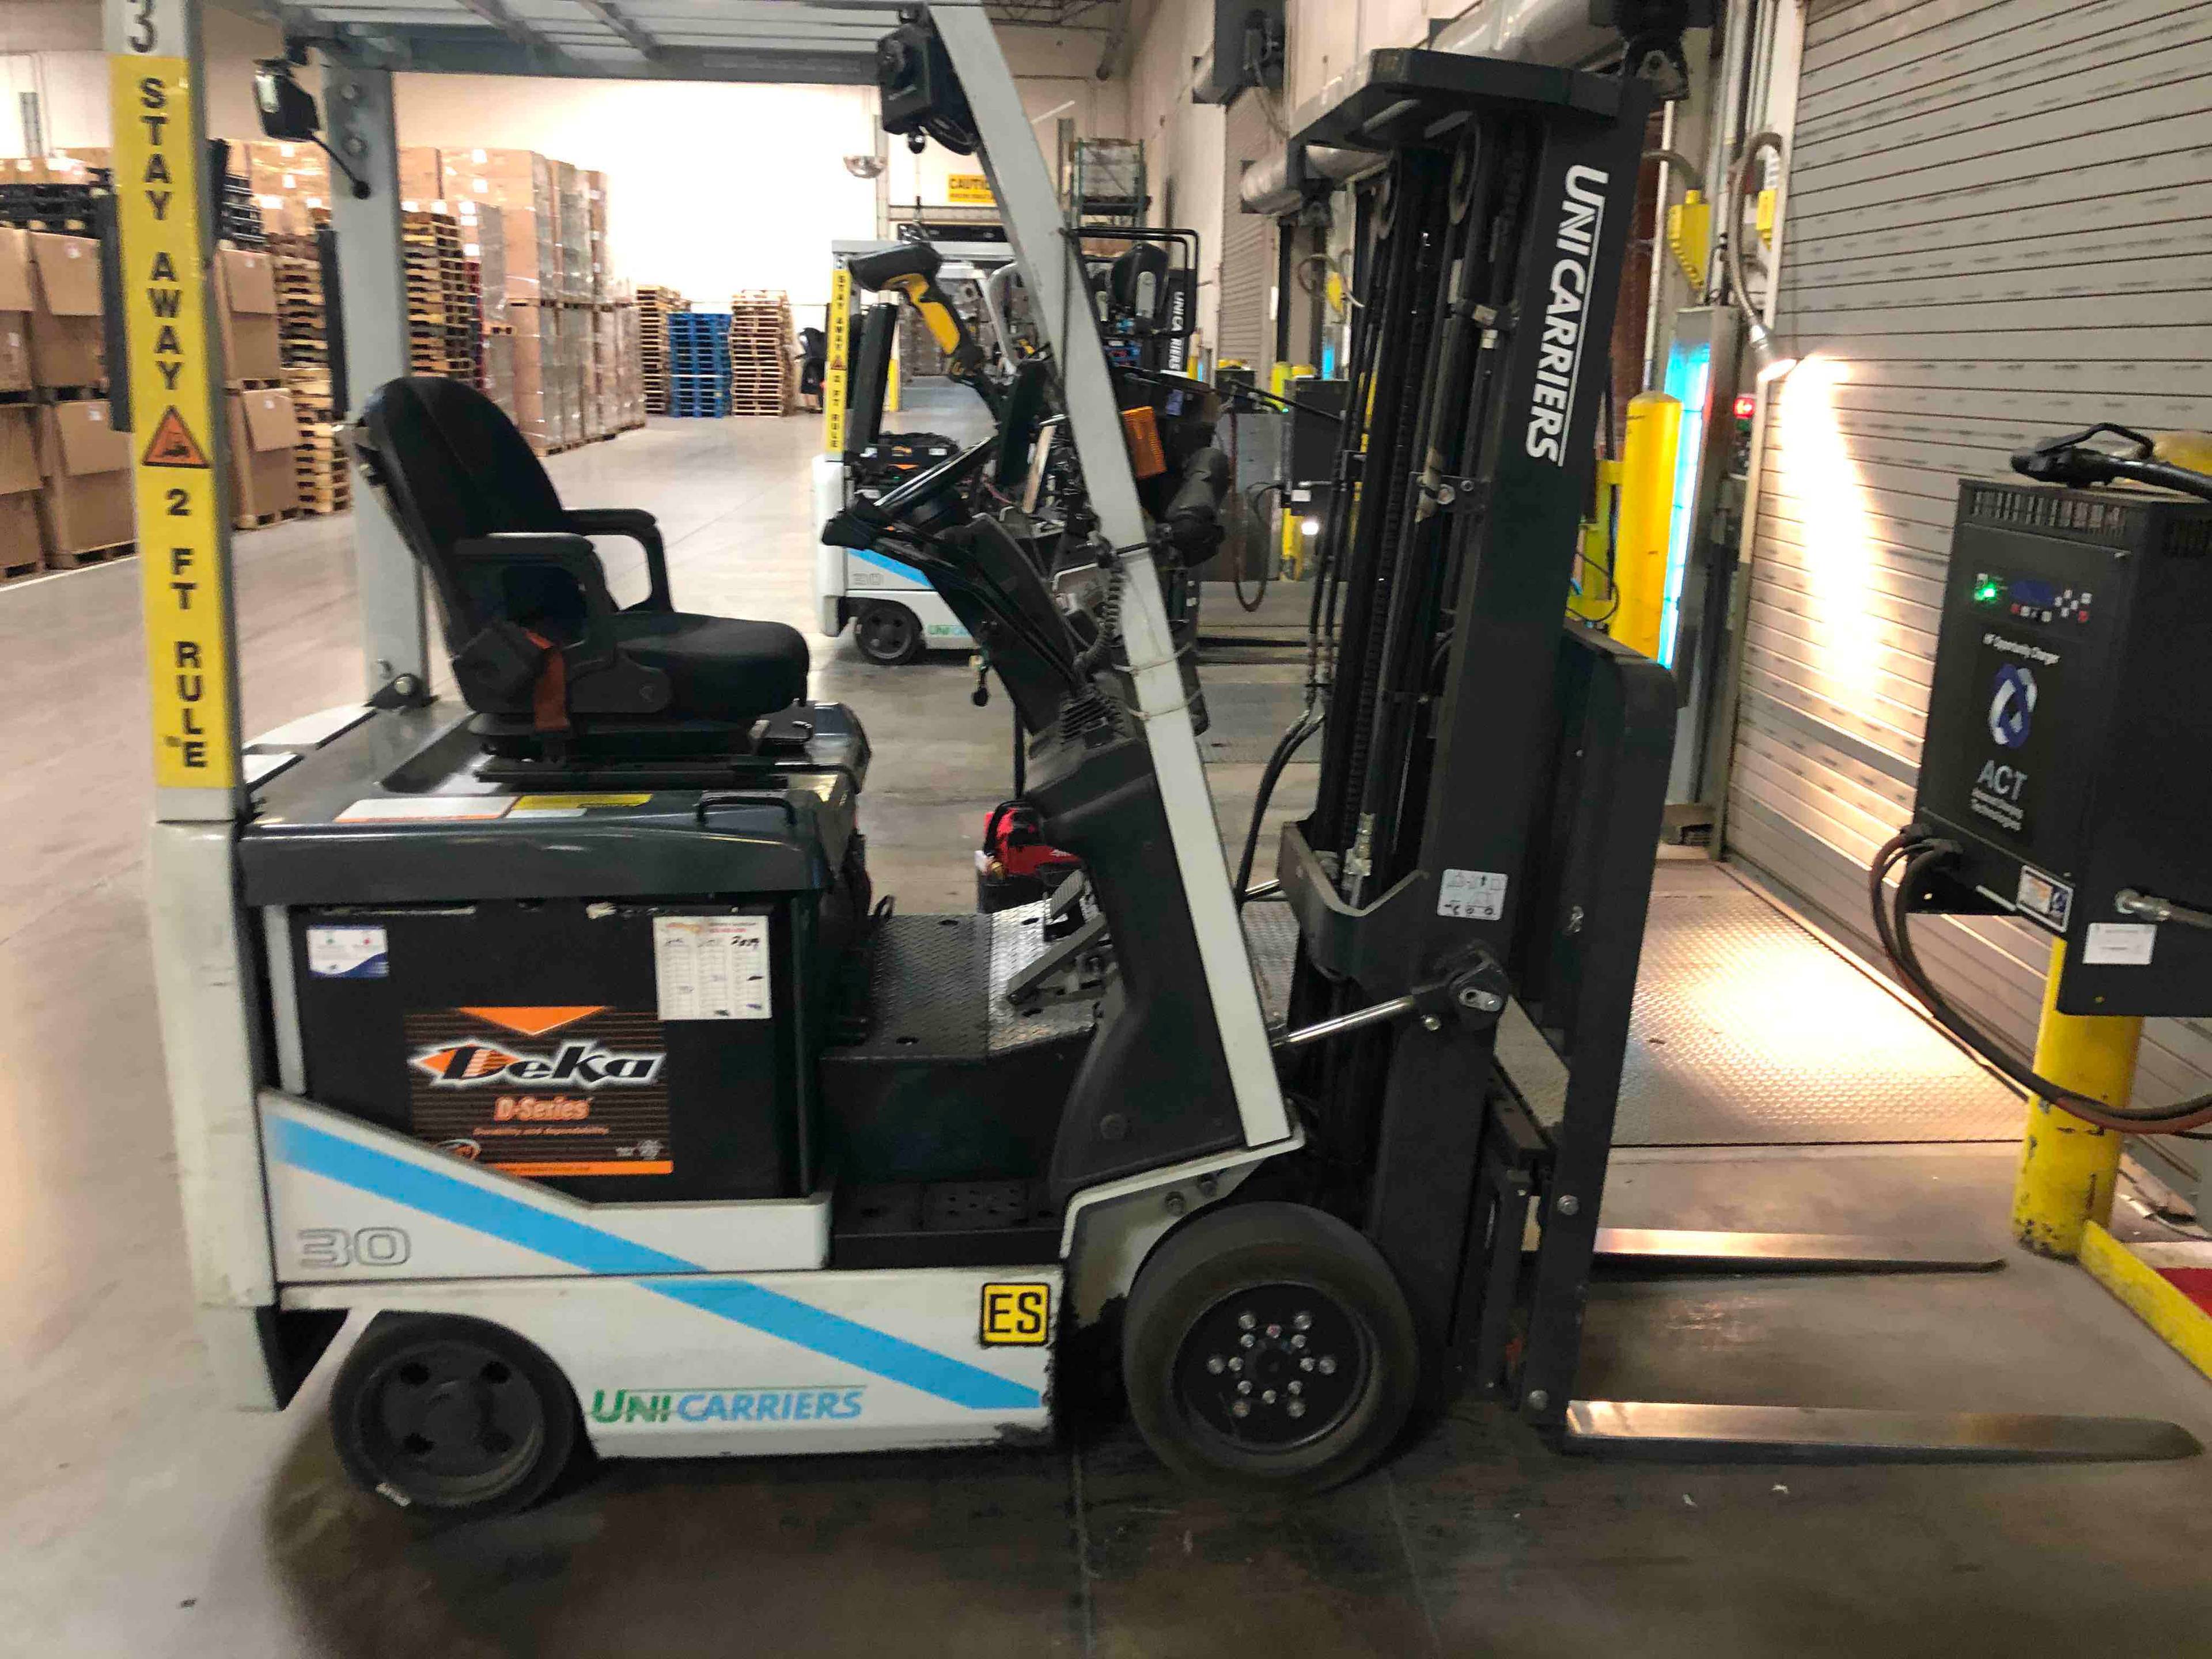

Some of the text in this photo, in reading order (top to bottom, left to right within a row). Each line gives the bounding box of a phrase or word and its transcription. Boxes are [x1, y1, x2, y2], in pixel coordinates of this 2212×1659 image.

[139, 77, 184, 391] STAY AWAY
[1168, 291, 1185, 370] UNICARIERS
[1525, 165, 1609, 465] UNICARRIERS
[165, 487, 208, 767] 2 FT RULE
[1978, 760, 2028, 800] ACT
[416, 1041, 661, 1086] Deka
[495, 1096, 590, 1122] D-Series
[296, 1227, 411, 1268] 30
[990, 1292, 1041, 1334] ES
[591, 1385, 863, 1423] UNICARRIERS
